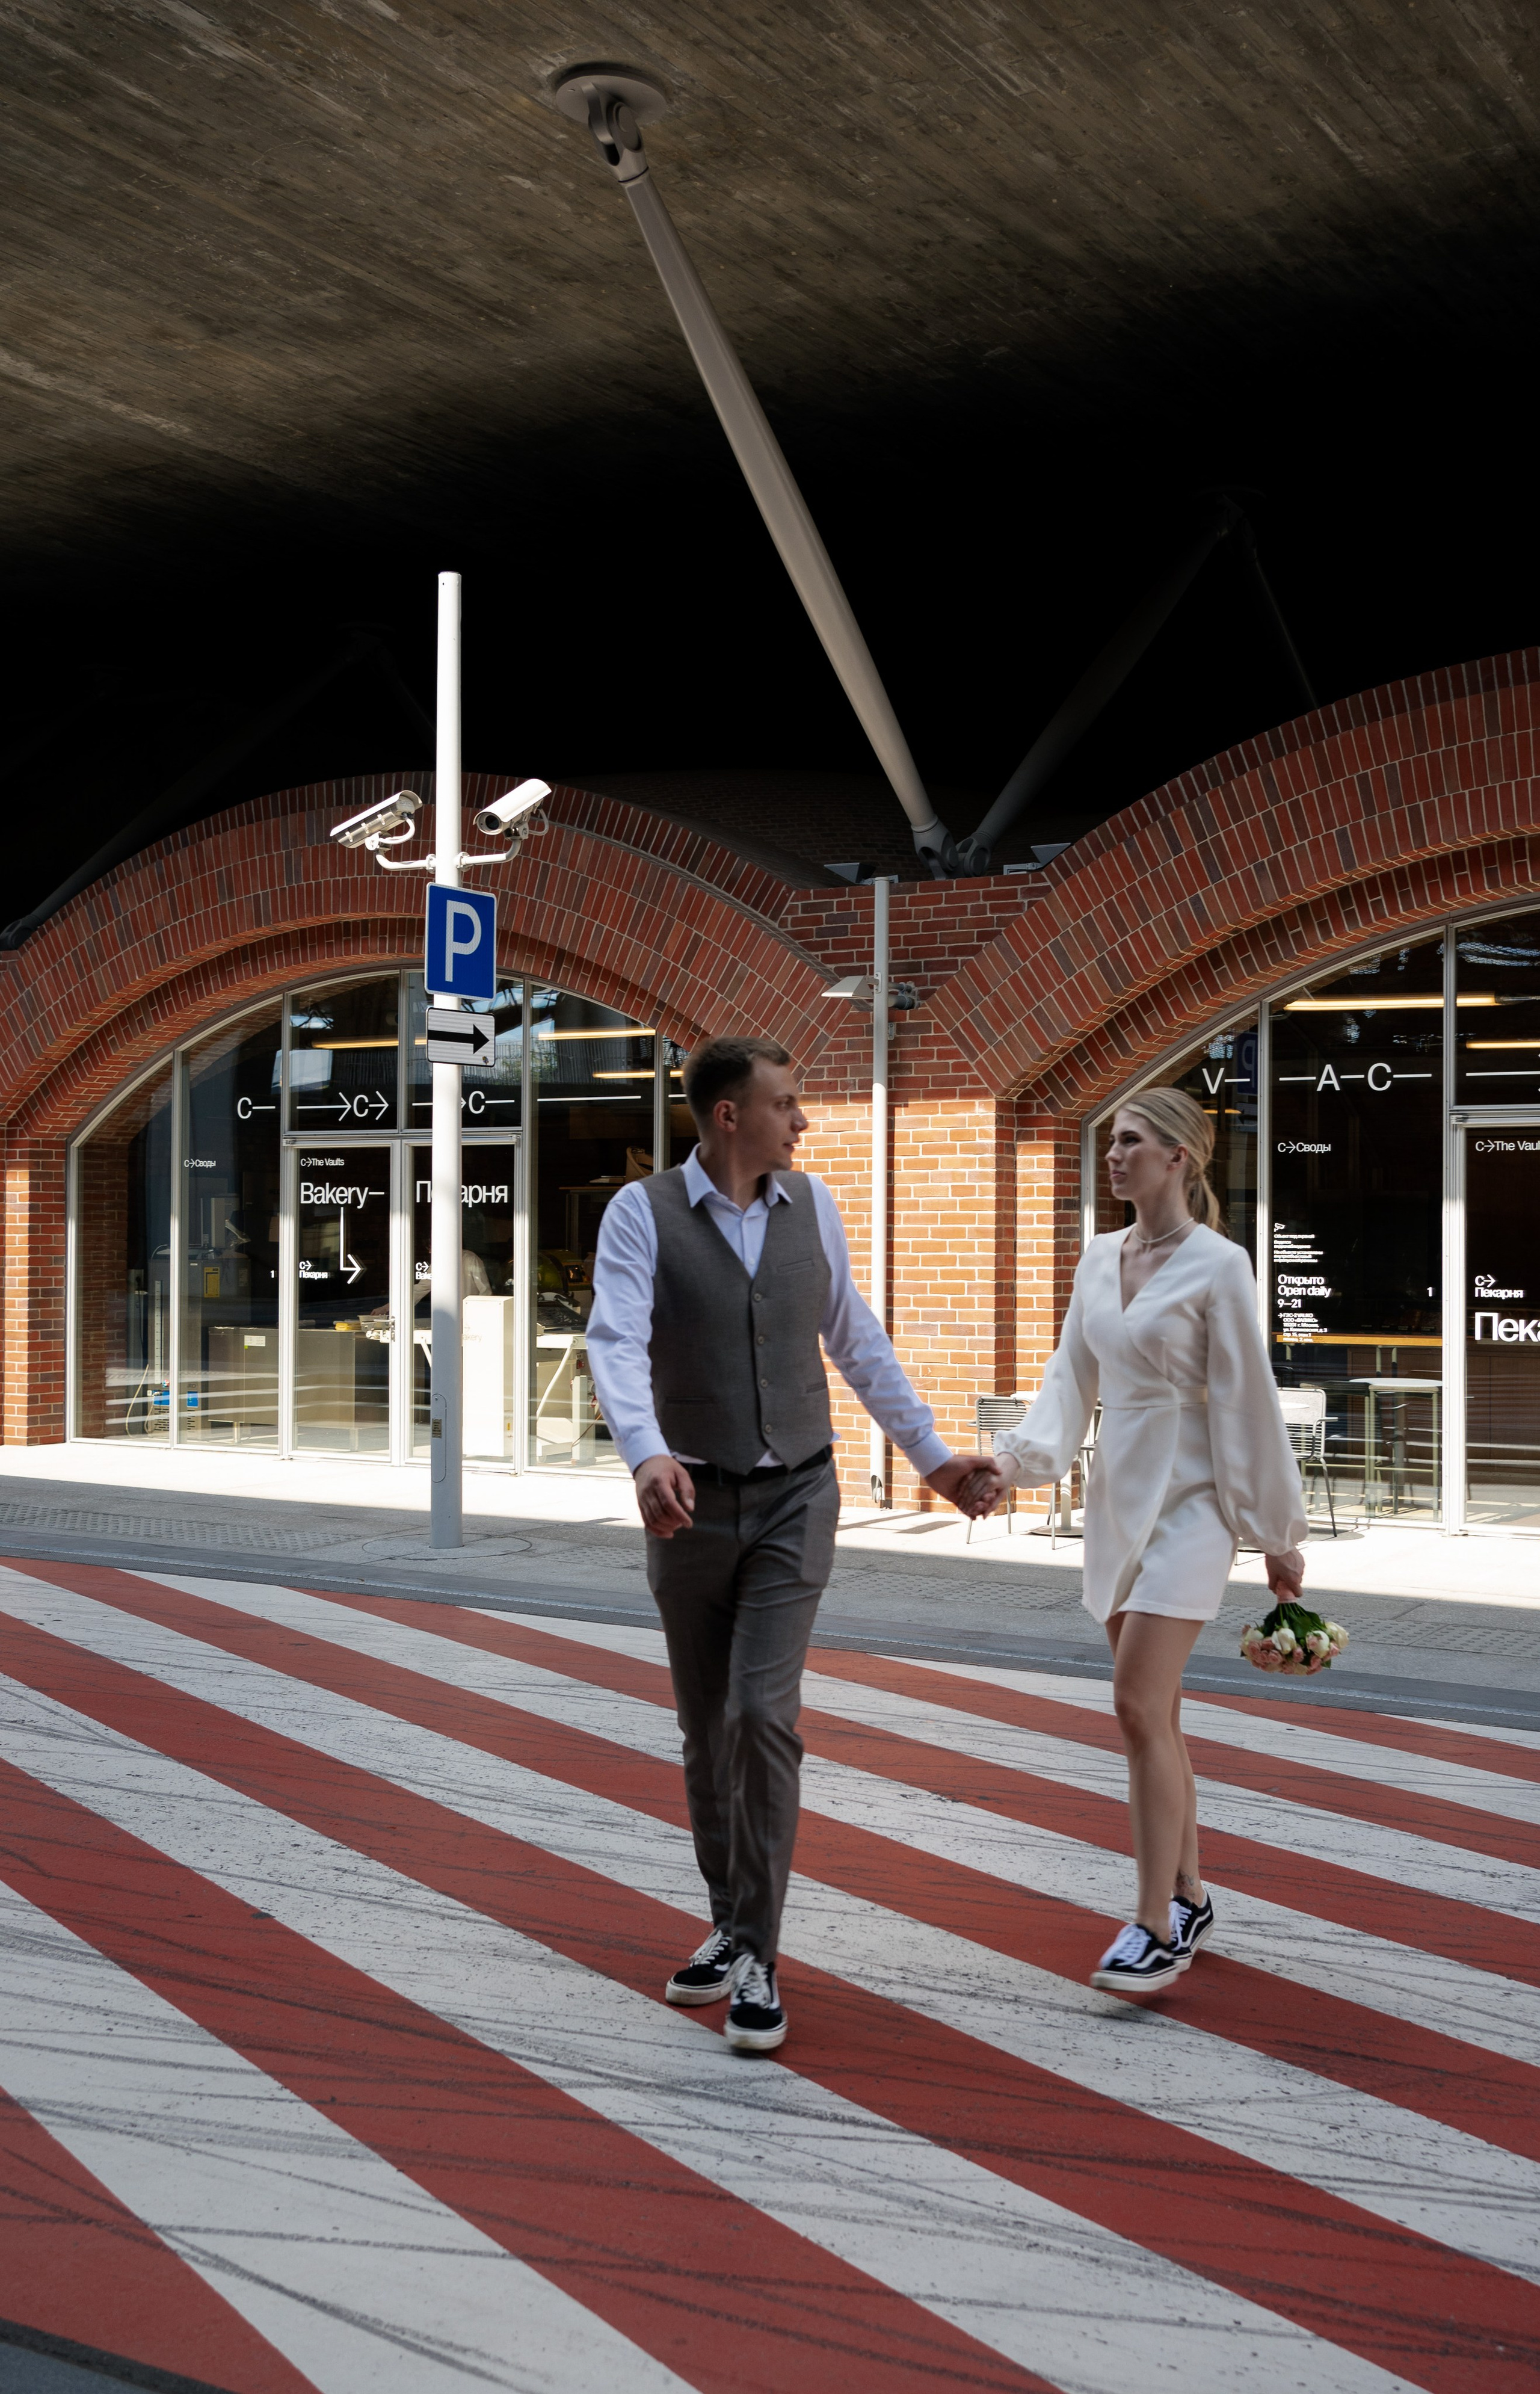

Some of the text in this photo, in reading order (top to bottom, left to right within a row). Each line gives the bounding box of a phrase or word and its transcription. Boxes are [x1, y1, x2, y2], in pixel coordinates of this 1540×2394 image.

[445, 899, 482, 982] P
[1493, 1141, 1516, 1151] The
[416, 1180, 508, 1208] Парня
[415, 1271, 433, 1280] Bake
[1277, 1274, 1325, 1286] Открыто
[1277, 1285, 1332, 1298] Open daily
[1474, 1287, 1524, 1300] Пекарня
[1474, 1312, 1540, 1342] Пек
